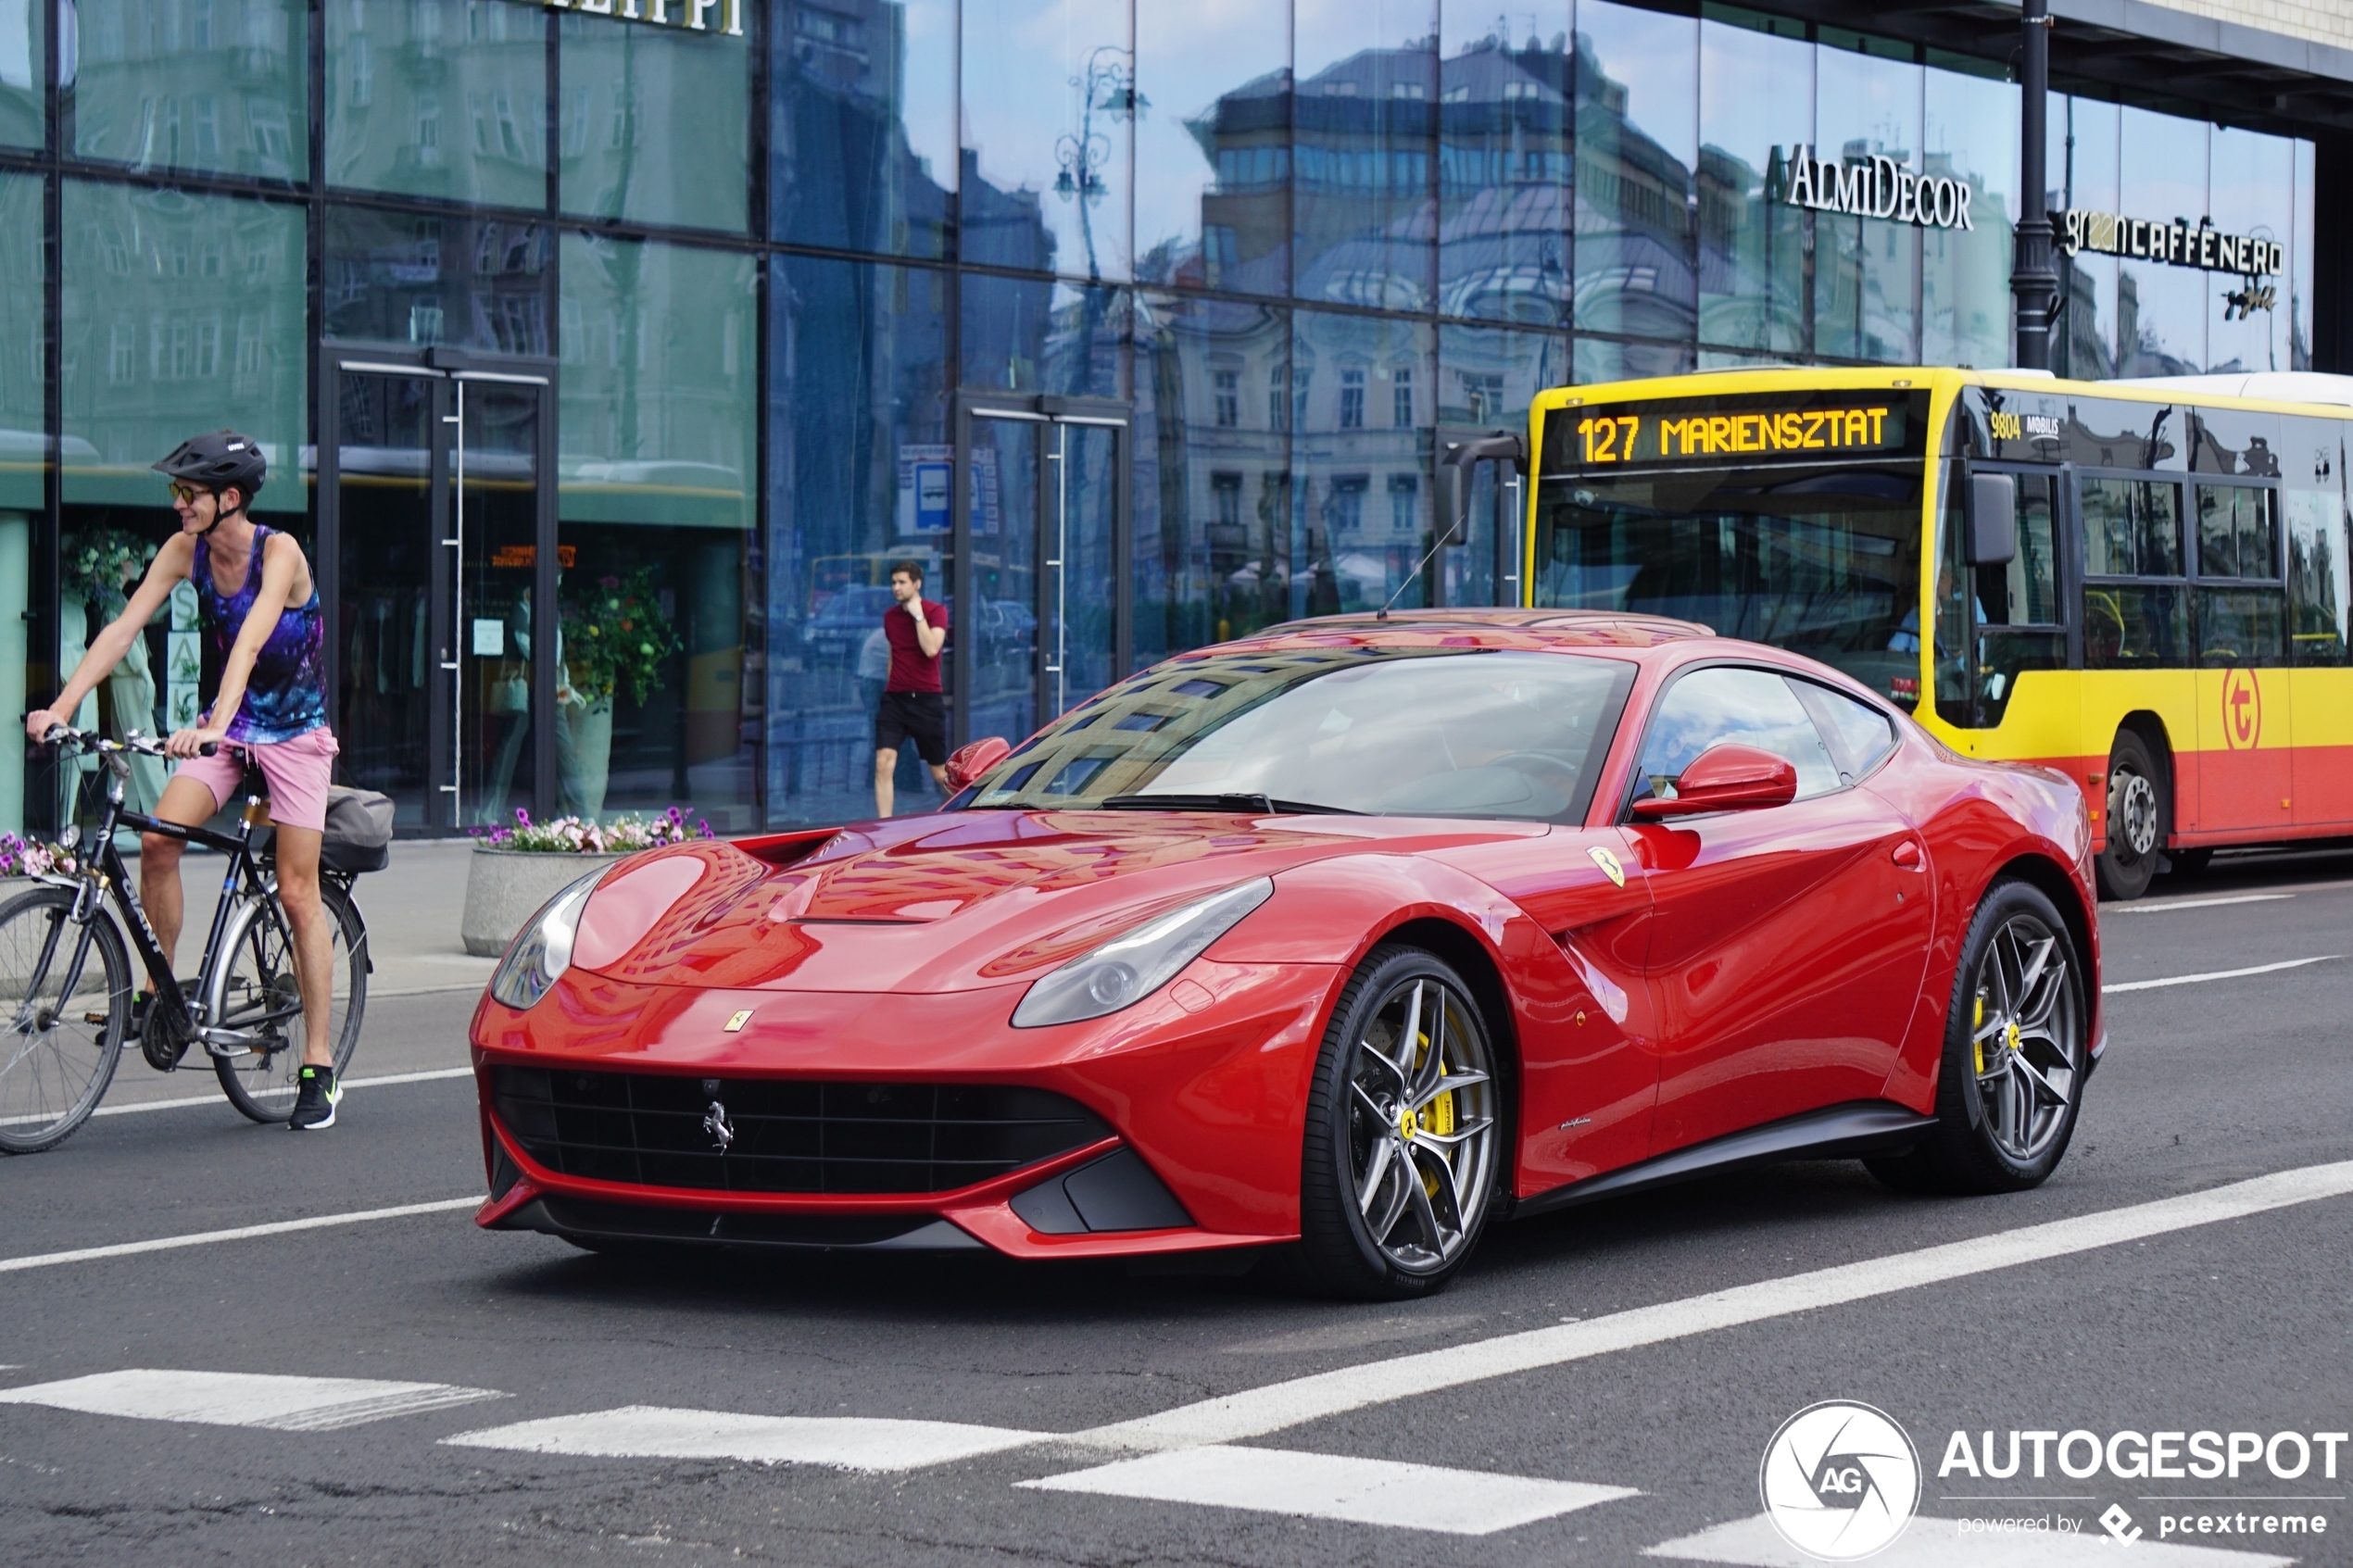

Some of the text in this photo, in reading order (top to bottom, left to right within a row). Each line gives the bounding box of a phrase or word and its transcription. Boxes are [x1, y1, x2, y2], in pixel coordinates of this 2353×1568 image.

[2065, 208, 2127, 257] green
[2220, 235, 2284, 276] NERO
[1579, 408, 1887, 461] 127 MARIENSZTAT
[1991, 411, 2058, 440] 9804 MOBILIS
[121, 878, 164, 954] GIANT
